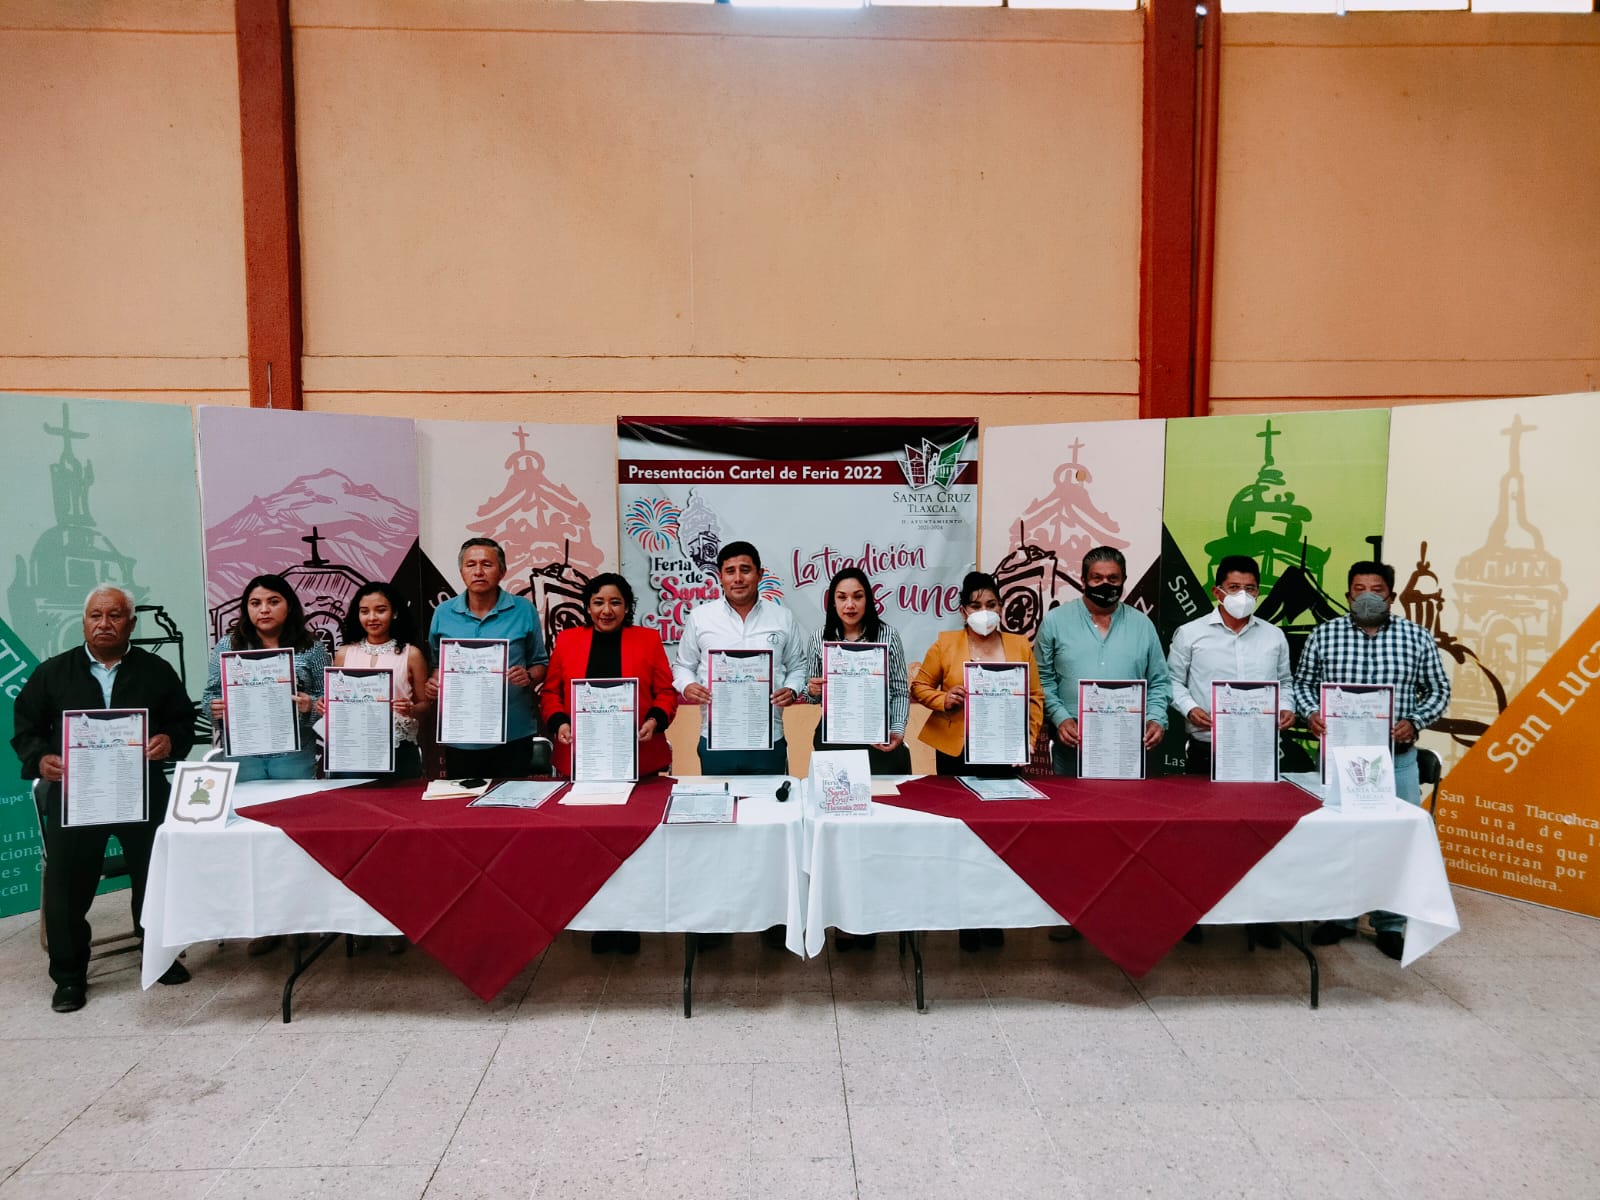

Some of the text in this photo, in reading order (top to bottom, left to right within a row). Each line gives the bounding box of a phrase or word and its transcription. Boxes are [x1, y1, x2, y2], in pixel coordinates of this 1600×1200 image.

[628, 464, 882, 480] Presentación Cartel de Feria 2022
[893, 491, 971, 503] SANTA CRUZ
[907, 503, 957, 513] TLAXCALA
[654, 557, 692, 572] Feria
[793, 549, 820, 588] La
[661, 576, 720, 601] Santa
[685, 572, 703, 583] de
[1168, 575, 1197, 616] San
[1487, 714, 1552, 774] San
[1164, 754, 1185, 767] Las
[0, 793, 23, 806] upe
[1440, 789, 1465, 804] San
[1475, 795, 1514, 813] Lucas
[1439, 808, 1458, 819] es
[1481, 815, 1515, 831] una
[1539, 825, 1563, 840] de
[1438, 824, 1588, 863] comunidades que
[1440, 840, 1586, 880] caracterizan por
[1444, 857, 1563, 892] radición mielera.
